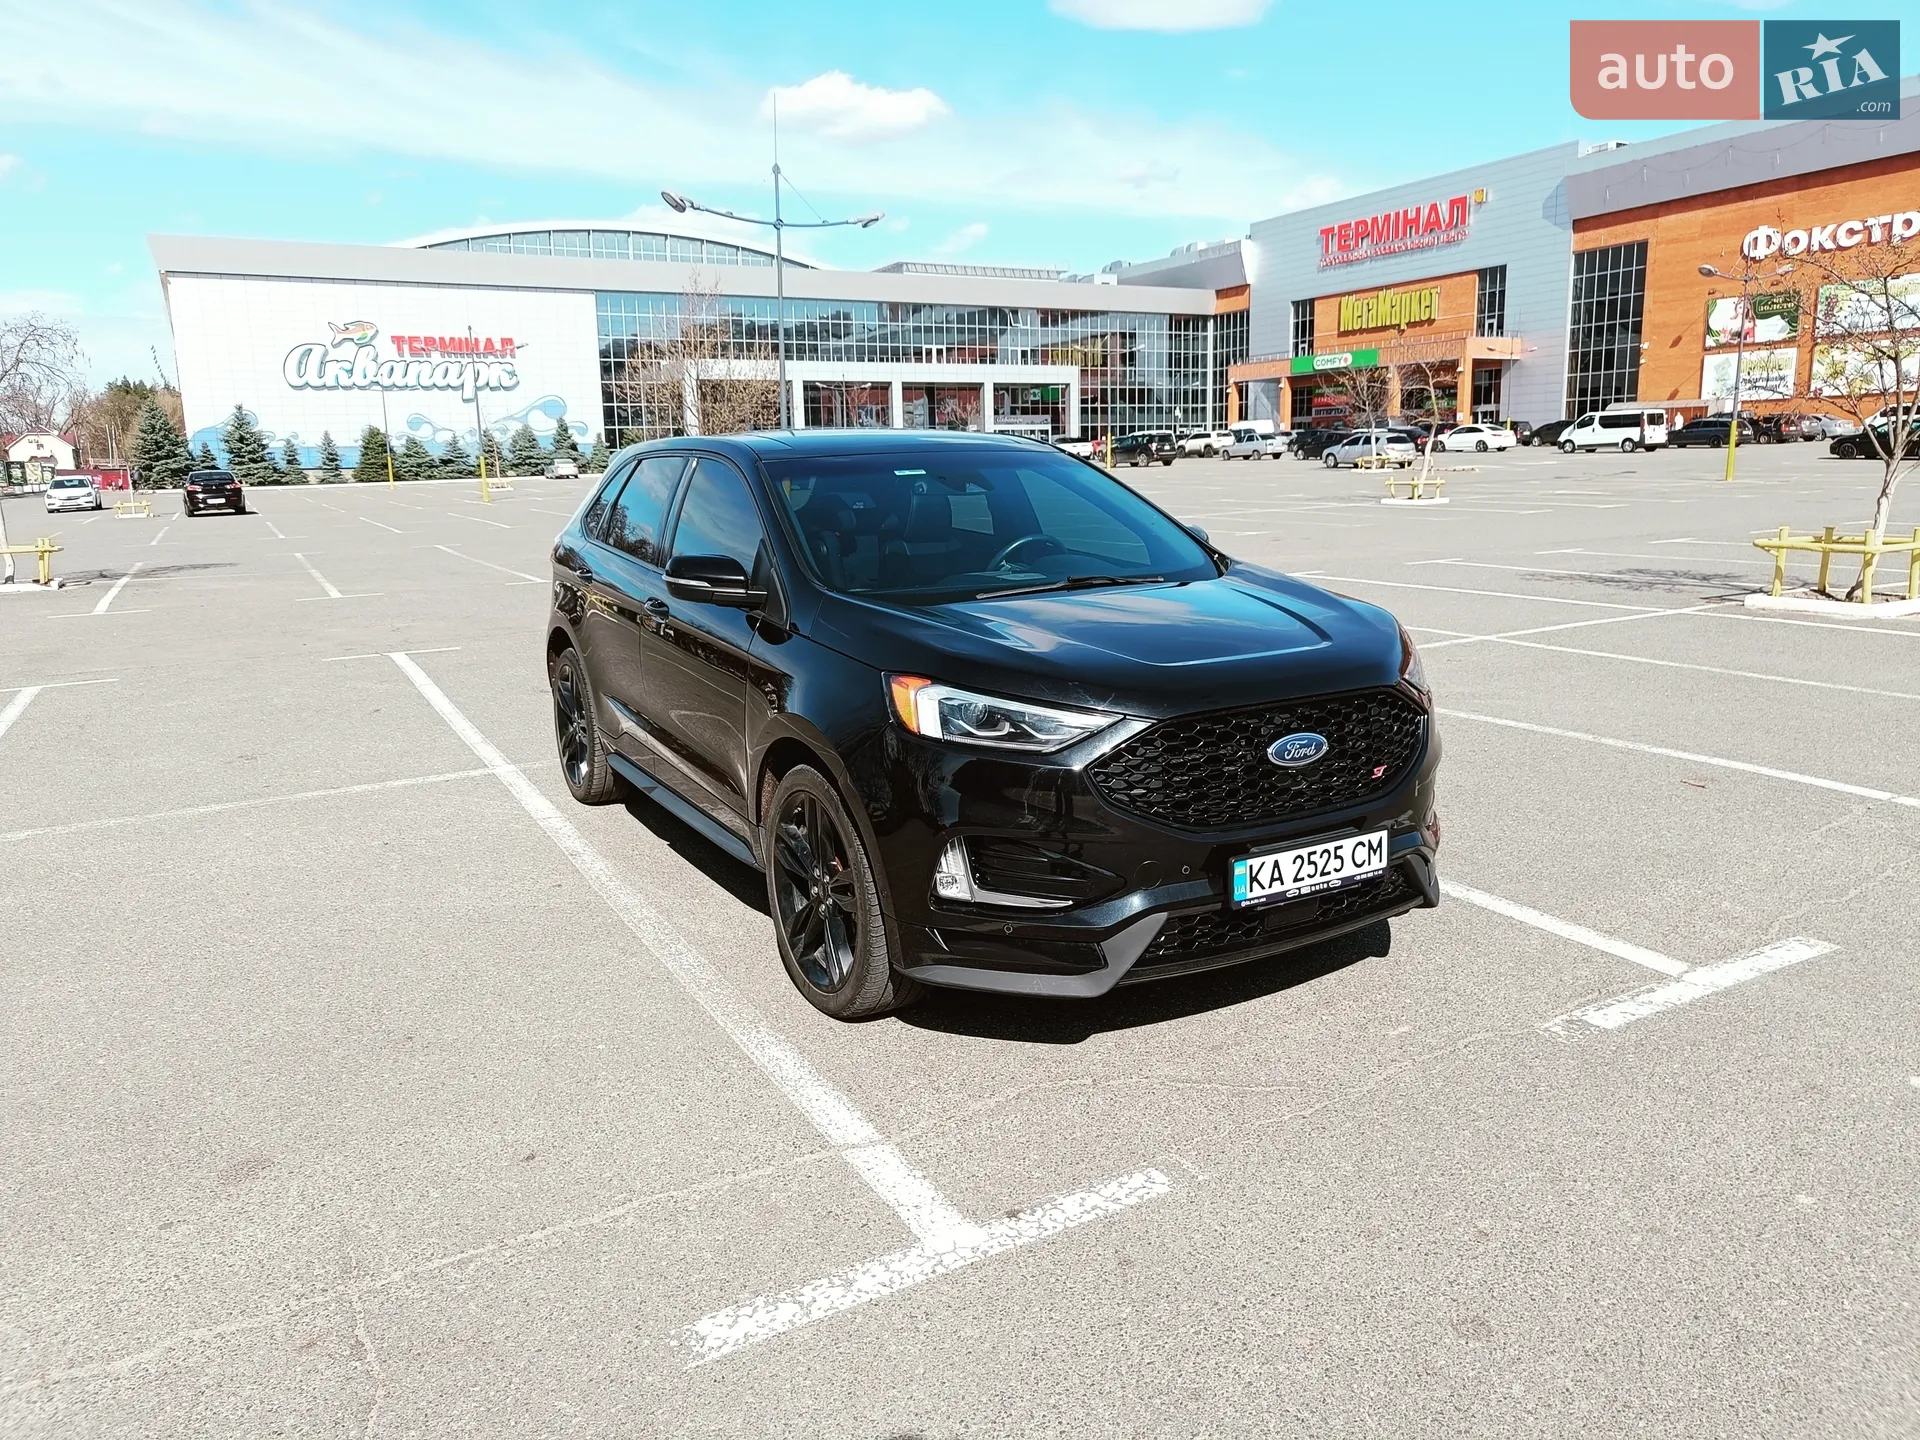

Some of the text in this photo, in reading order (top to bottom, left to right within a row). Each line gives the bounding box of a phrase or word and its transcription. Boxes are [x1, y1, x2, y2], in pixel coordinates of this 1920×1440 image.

[1319, 194, 1469, 254] ТЕРМІНАЛ
[1339, 286, 1441, 333] МегаМаркет
[391, 335, 516, 356] ТЕРМІНАЛ
[1315, 357, 1343, 367] COMFY
[283, 343, 520, 403] Аквапарк
[1284, 739, 1317, 760] Ford
[1249, 836, 1383, 893] KA 2525 CM
[1235, 884, 1246, 895] UA
